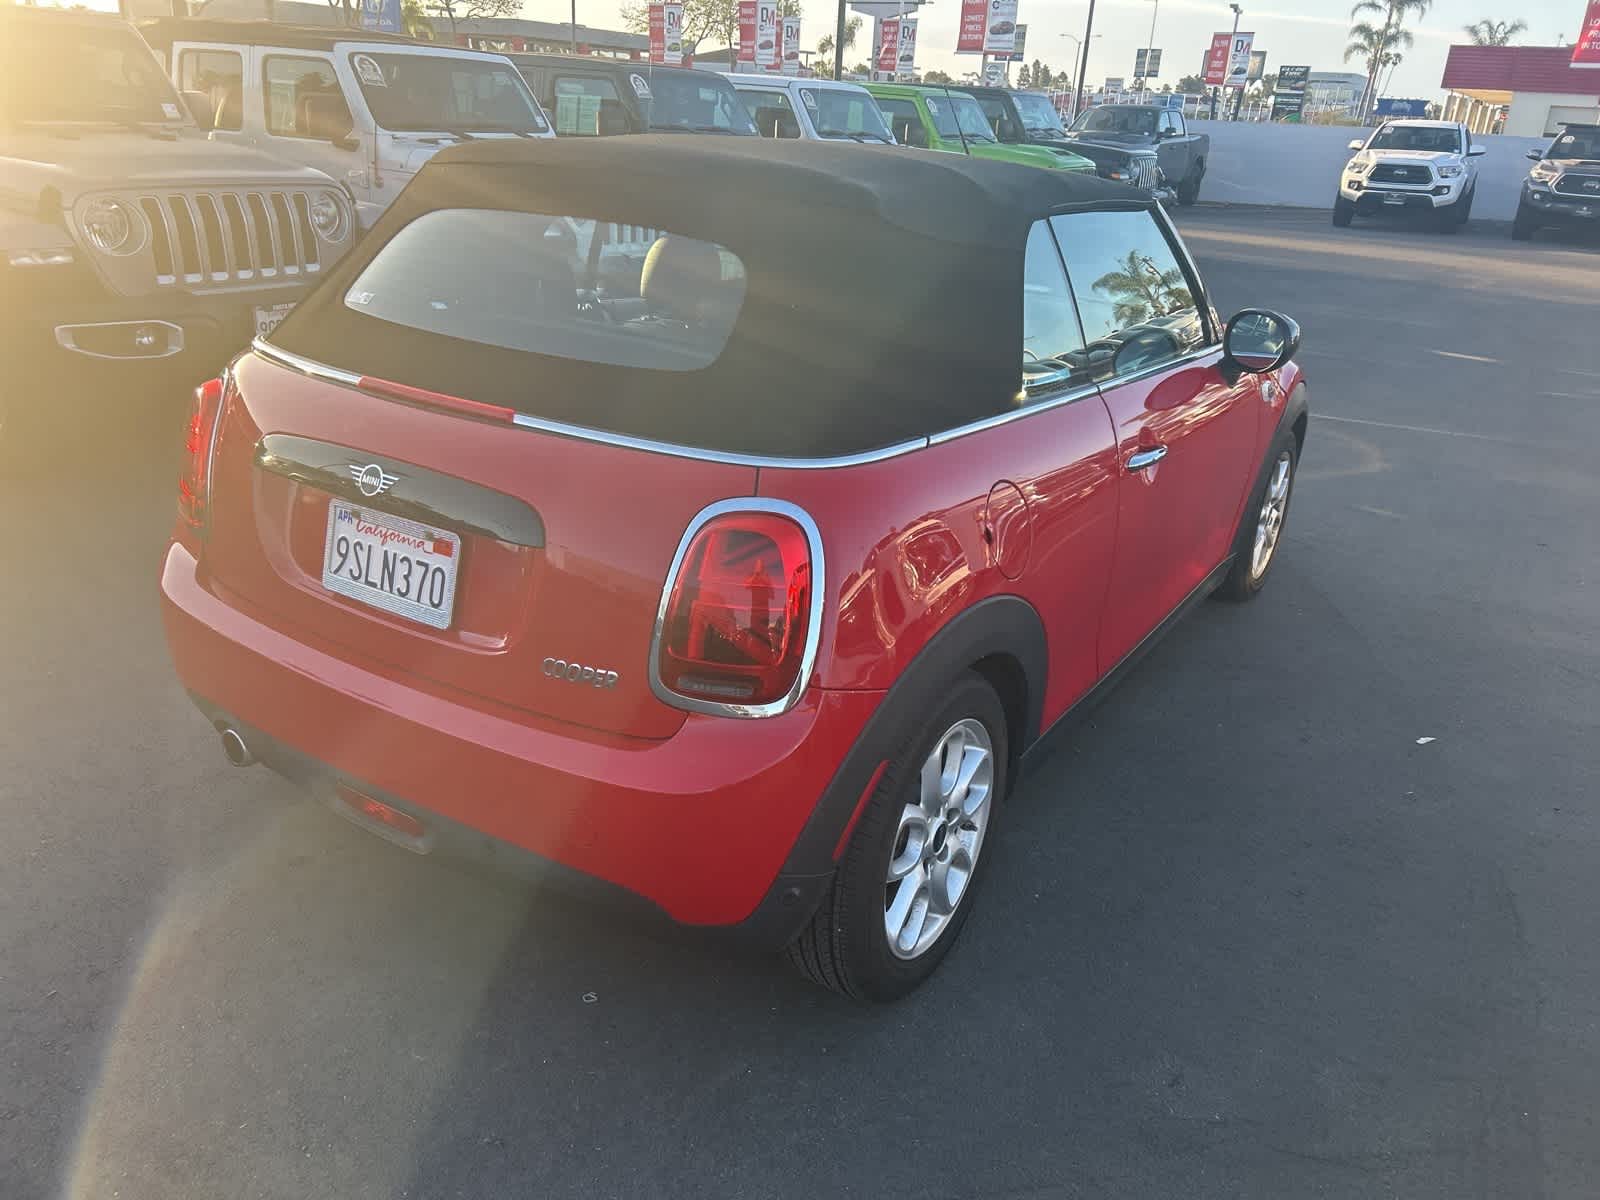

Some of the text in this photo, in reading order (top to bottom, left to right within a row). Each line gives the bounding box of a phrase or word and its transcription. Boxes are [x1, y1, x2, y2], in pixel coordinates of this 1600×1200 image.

[361, 473, 380, 487] MINI
[355, 518, 434, 556] California
[332, 535, 447, 610] 9SLN370
[542, 657, 619, 690] COOPER
